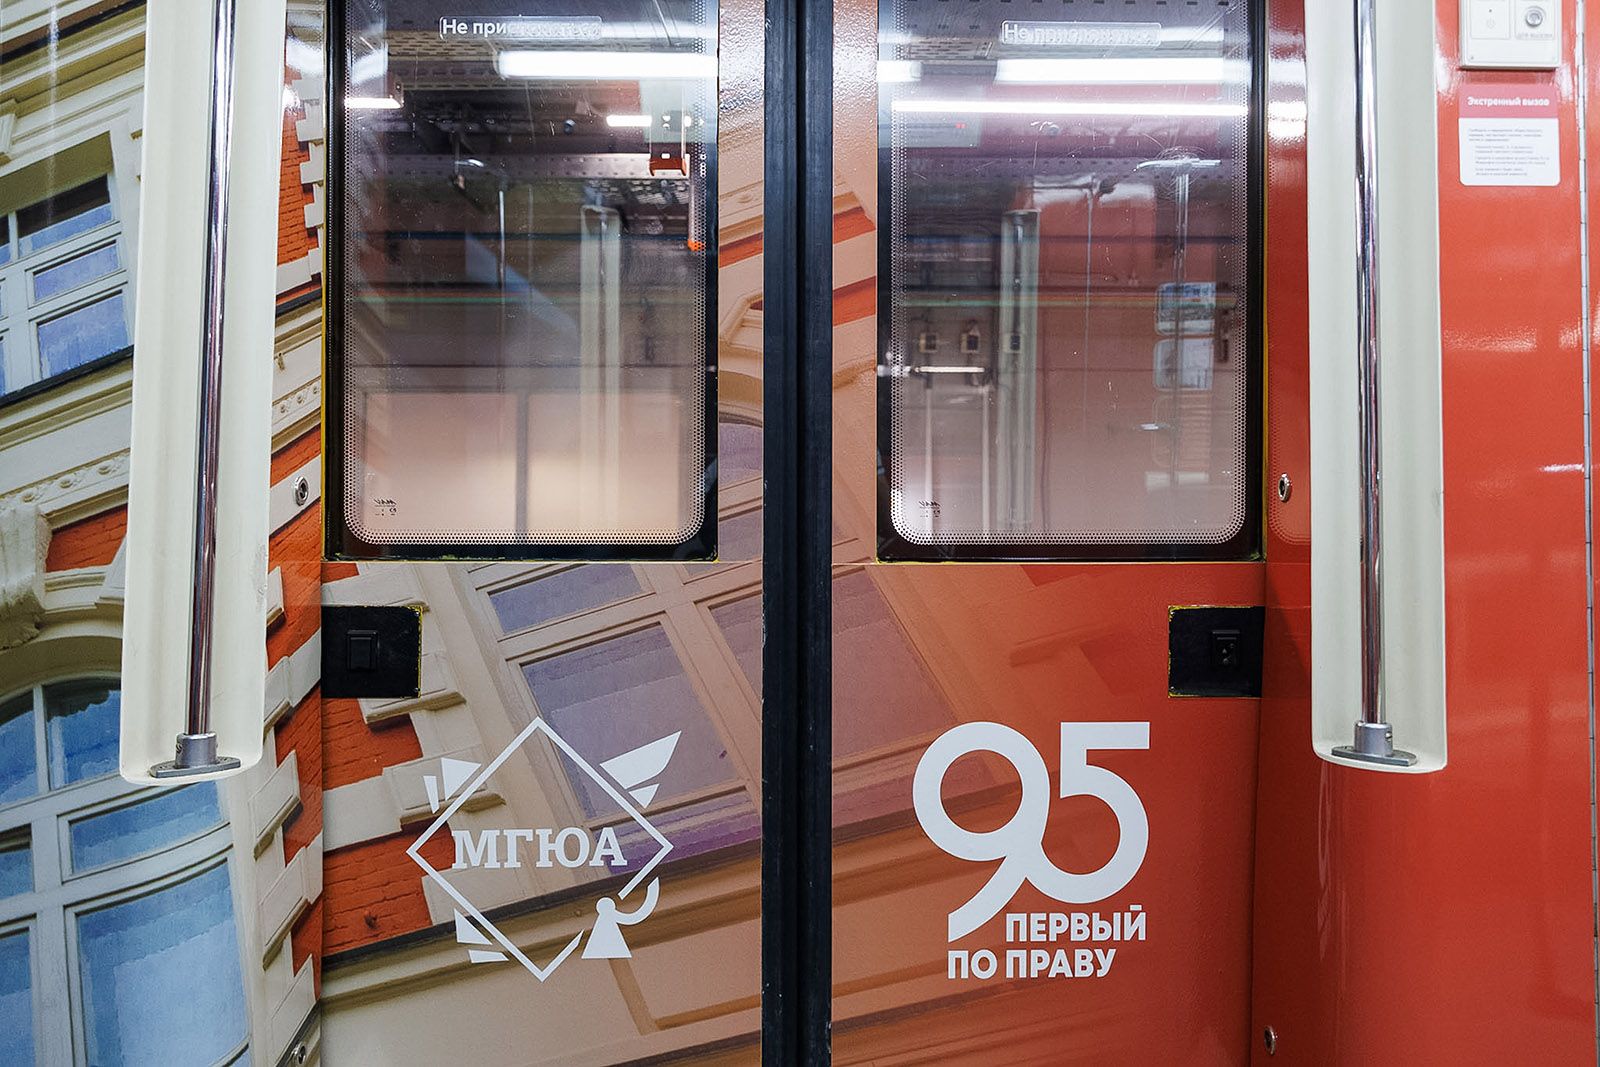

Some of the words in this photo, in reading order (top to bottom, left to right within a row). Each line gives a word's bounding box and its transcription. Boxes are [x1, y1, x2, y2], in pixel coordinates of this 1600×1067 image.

[442, 19, 467, 35] Не
[1467, 97, 1521, 107] Экстренный
[1522, 98, 1549, 106] вызов
[451, 827, 628, 869] МГЮА
[912, 721, 1150, 943] 95
[1006, 904, 1147, 942] ПЕРВЫЙ
[948, 949, 998, 980] ПО
[1006, 949, 1116, 978] ПРАВУ
